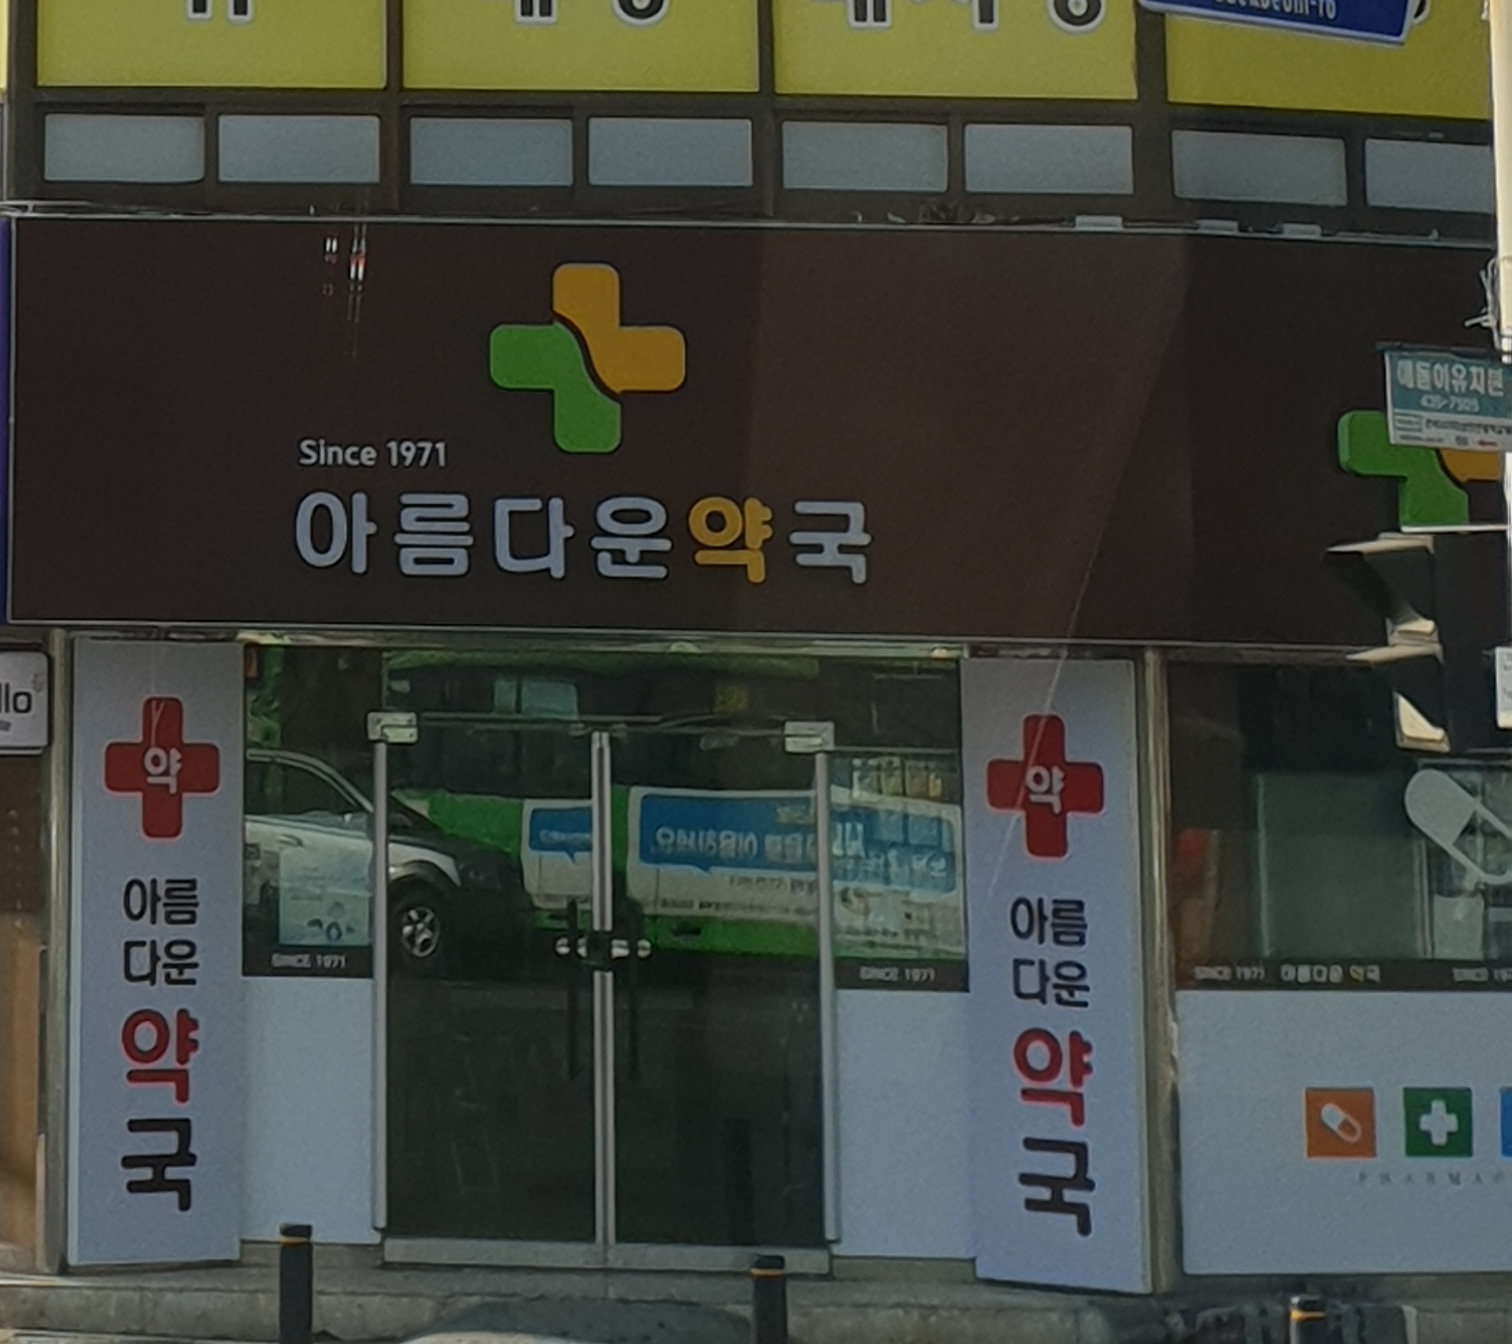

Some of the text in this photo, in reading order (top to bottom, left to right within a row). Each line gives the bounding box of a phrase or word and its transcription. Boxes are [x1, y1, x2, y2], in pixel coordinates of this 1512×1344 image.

[298, 438, 448, 468] Since 1971
[143, 745, 182, 794] 약
[1024, 764, 1066, 814] 약
[123, 877, 200, 926] 아름
[1009, 896, 1089, 949] 아름
[123, 938, 200, 987] 다운
[1010, 957, 1091, 1009] 다운
[121, 1008, 200, 1213] 약국
[1013, 1027, 1096, 1238] 약국
